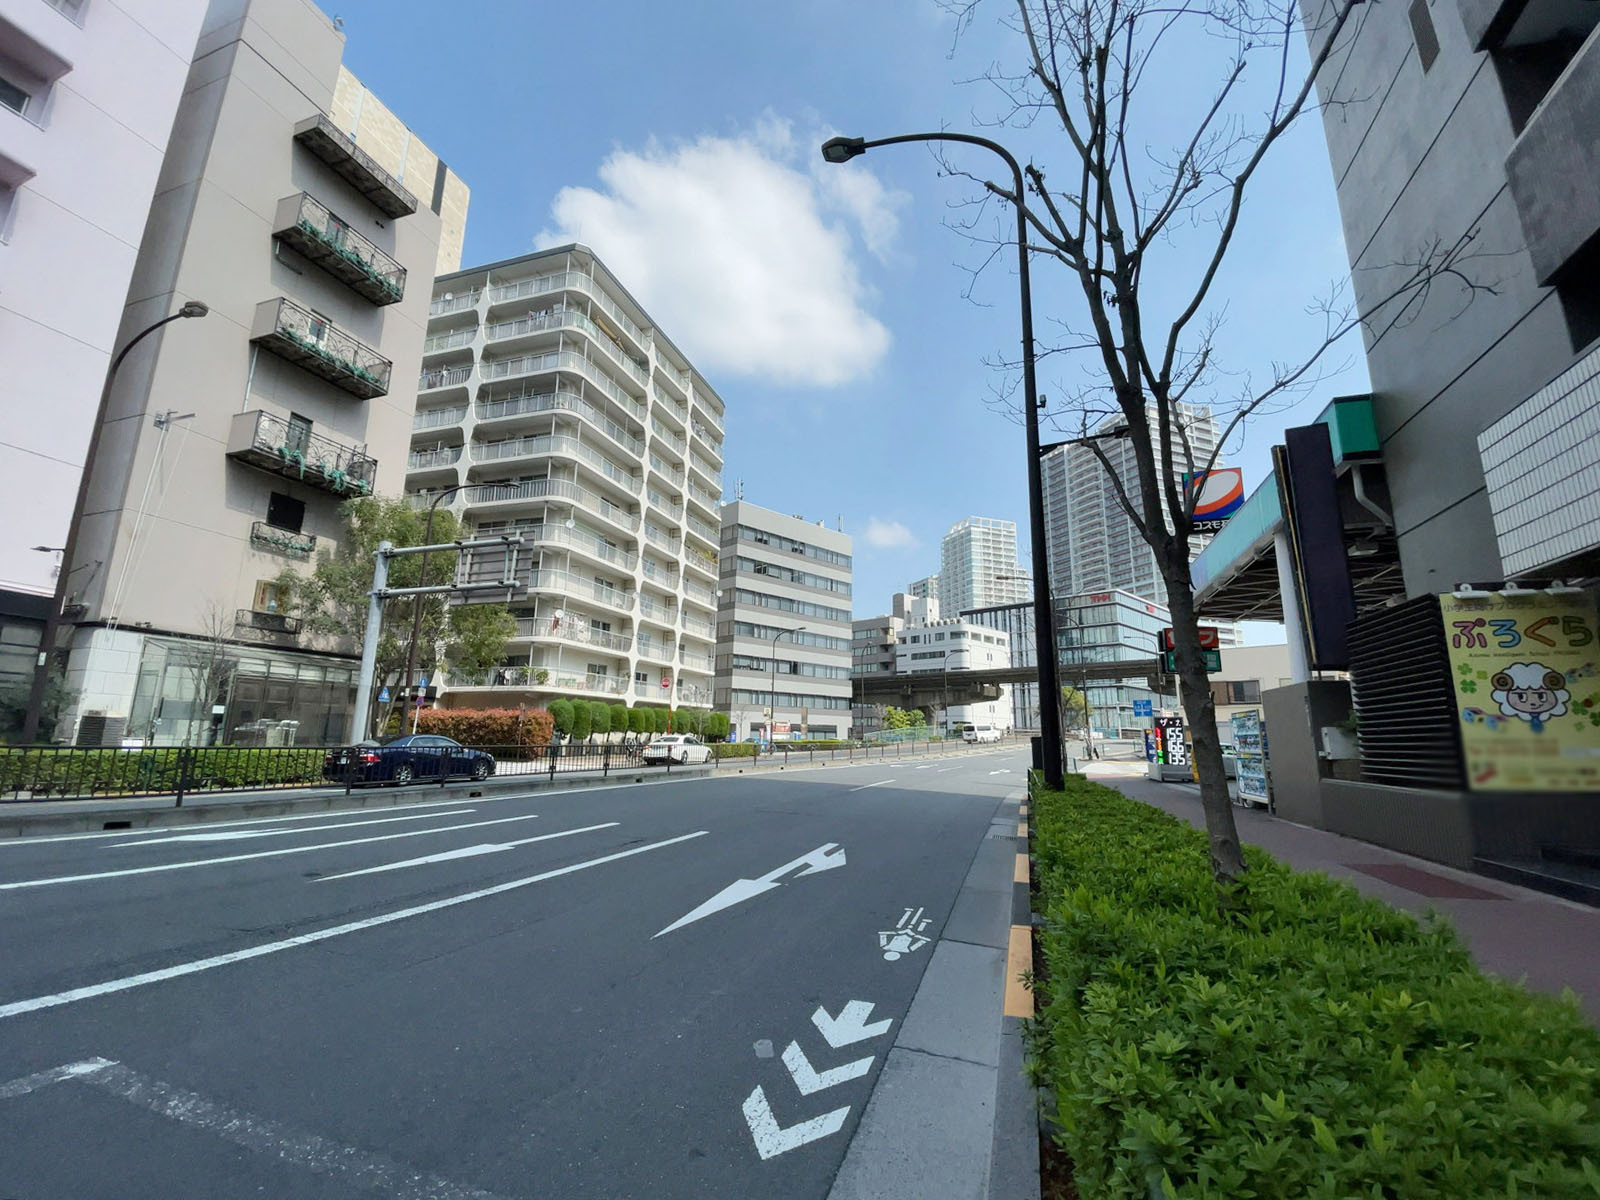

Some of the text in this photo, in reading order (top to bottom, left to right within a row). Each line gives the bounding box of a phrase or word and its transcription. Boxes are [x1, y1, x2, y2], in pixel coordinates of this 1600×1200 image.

[1166, 727, 1183, 740] 155
[1167, 740, 1184, 752] 166
[1168, 752, 1186, 765] 135
